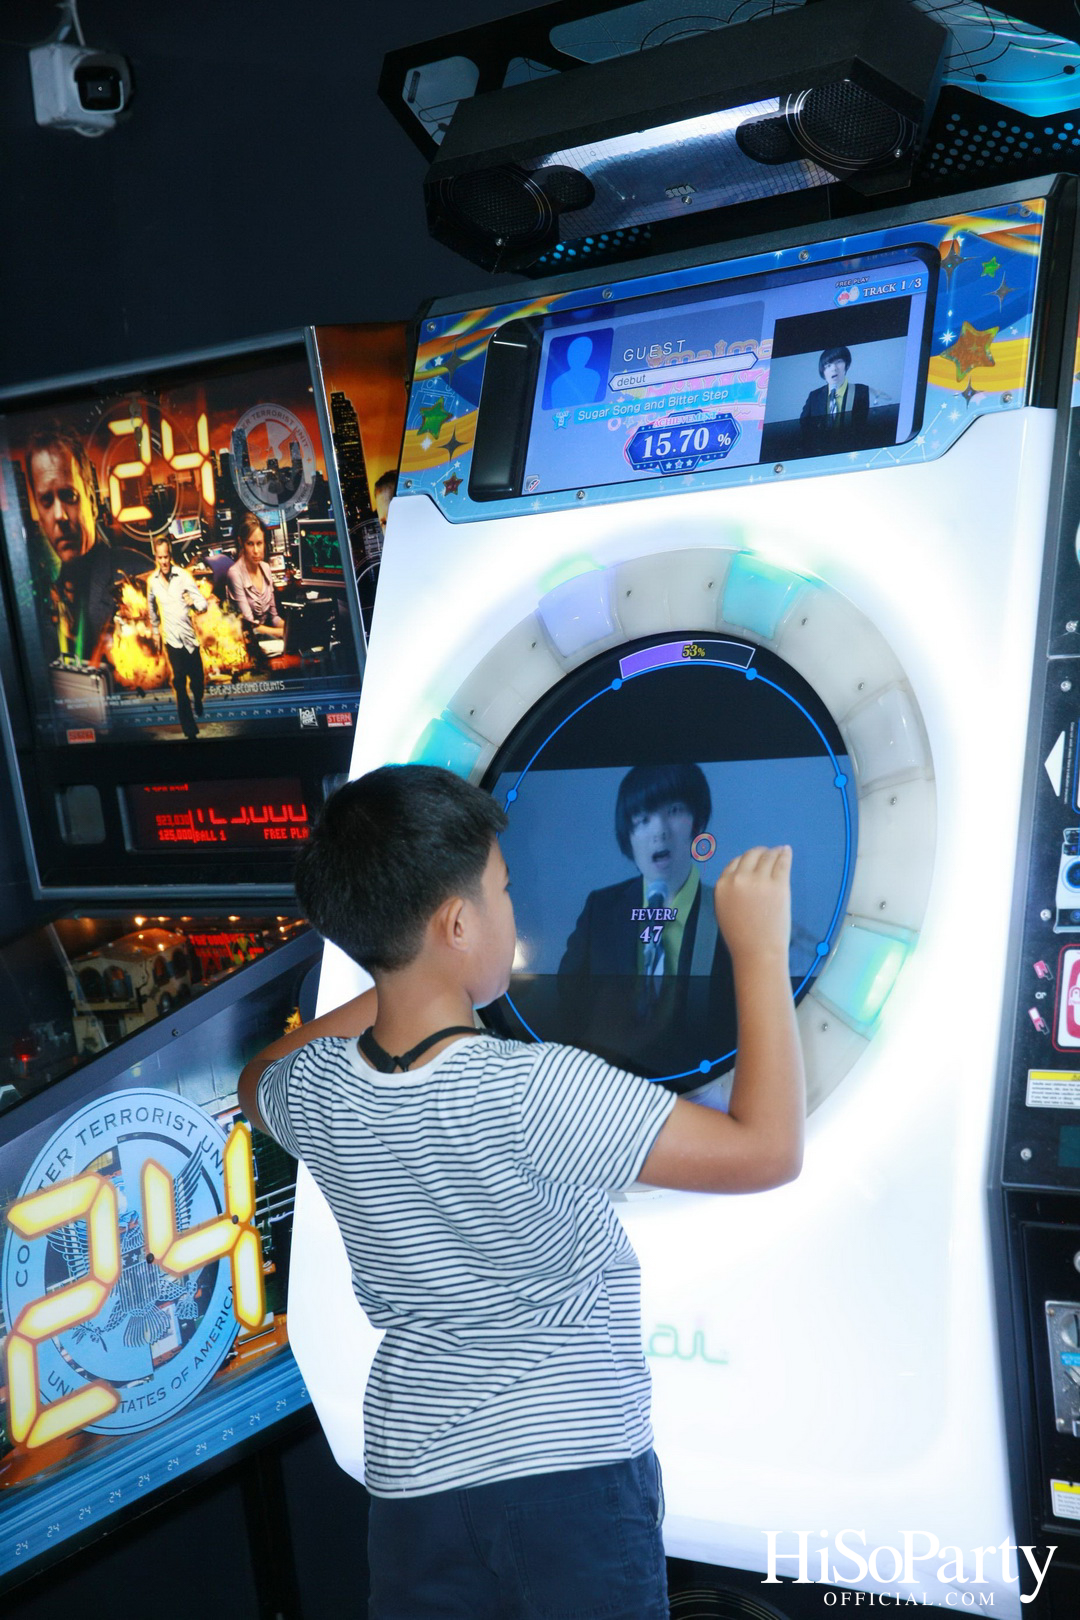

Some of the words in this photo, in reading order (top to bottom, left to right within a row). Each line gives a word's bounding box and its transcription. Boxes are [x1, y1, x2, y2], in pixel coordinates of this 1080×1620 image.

[835, 280, 851, 288] FREE
[853, 276, 869, 285] PLAY
[863, 283, 897, 298] TRACK
[623, 339, 686, 363] GUEST
[616, 374, 647, 388] debut
[577, 407, 610, 422] Sugar
[612, 402, 641, 416] Song
[643, 400, 666, 412] and
[668, 393, 700, 408] Bitter
[702, 390, 730, 403] Step
[654, 411, 717, 428] ACHIEVEMENT
[642, 427, 710, 459] 15.70
[717, 433, 732, 448] %
[107, 412, 216, 524] 24
[682, 644, 706, 658] 53%
[209, 685, 232, 696] EVERY
[232, 682, 259, 694] SECOND
[259, 680, 285, 692] COUNTS
[327, 713, 351, 723] STERN
[263, 828, 288, 840] FREE
[290, 827, 309, 840] PLA
[630, 908, 678, 921] FEVER!
[639, 925, 664, 943] 47
[75, 1106, 198, 1146] TERRORIST
[6, 1120, 265, 1450] 24
[112, 1387, 167, 1415] TATES
[171, 1366, 190, 1390] OF
[15, 1540, 29, 1556] 24
[47, 1522, 60, 1538] 24
[79, 1505, 91, 1520] 24
[109, 1488, 122, 1503] 24
[138, 1473, 150, 1488] 24
[167, 1457, 179, 1471] 24
[195, 1442, 207, 1456] 24
[222, 1427, 234, 1441] 24
[249, 1412, 261, 1426] 24
[275, 1398, 287, 1412] 24
